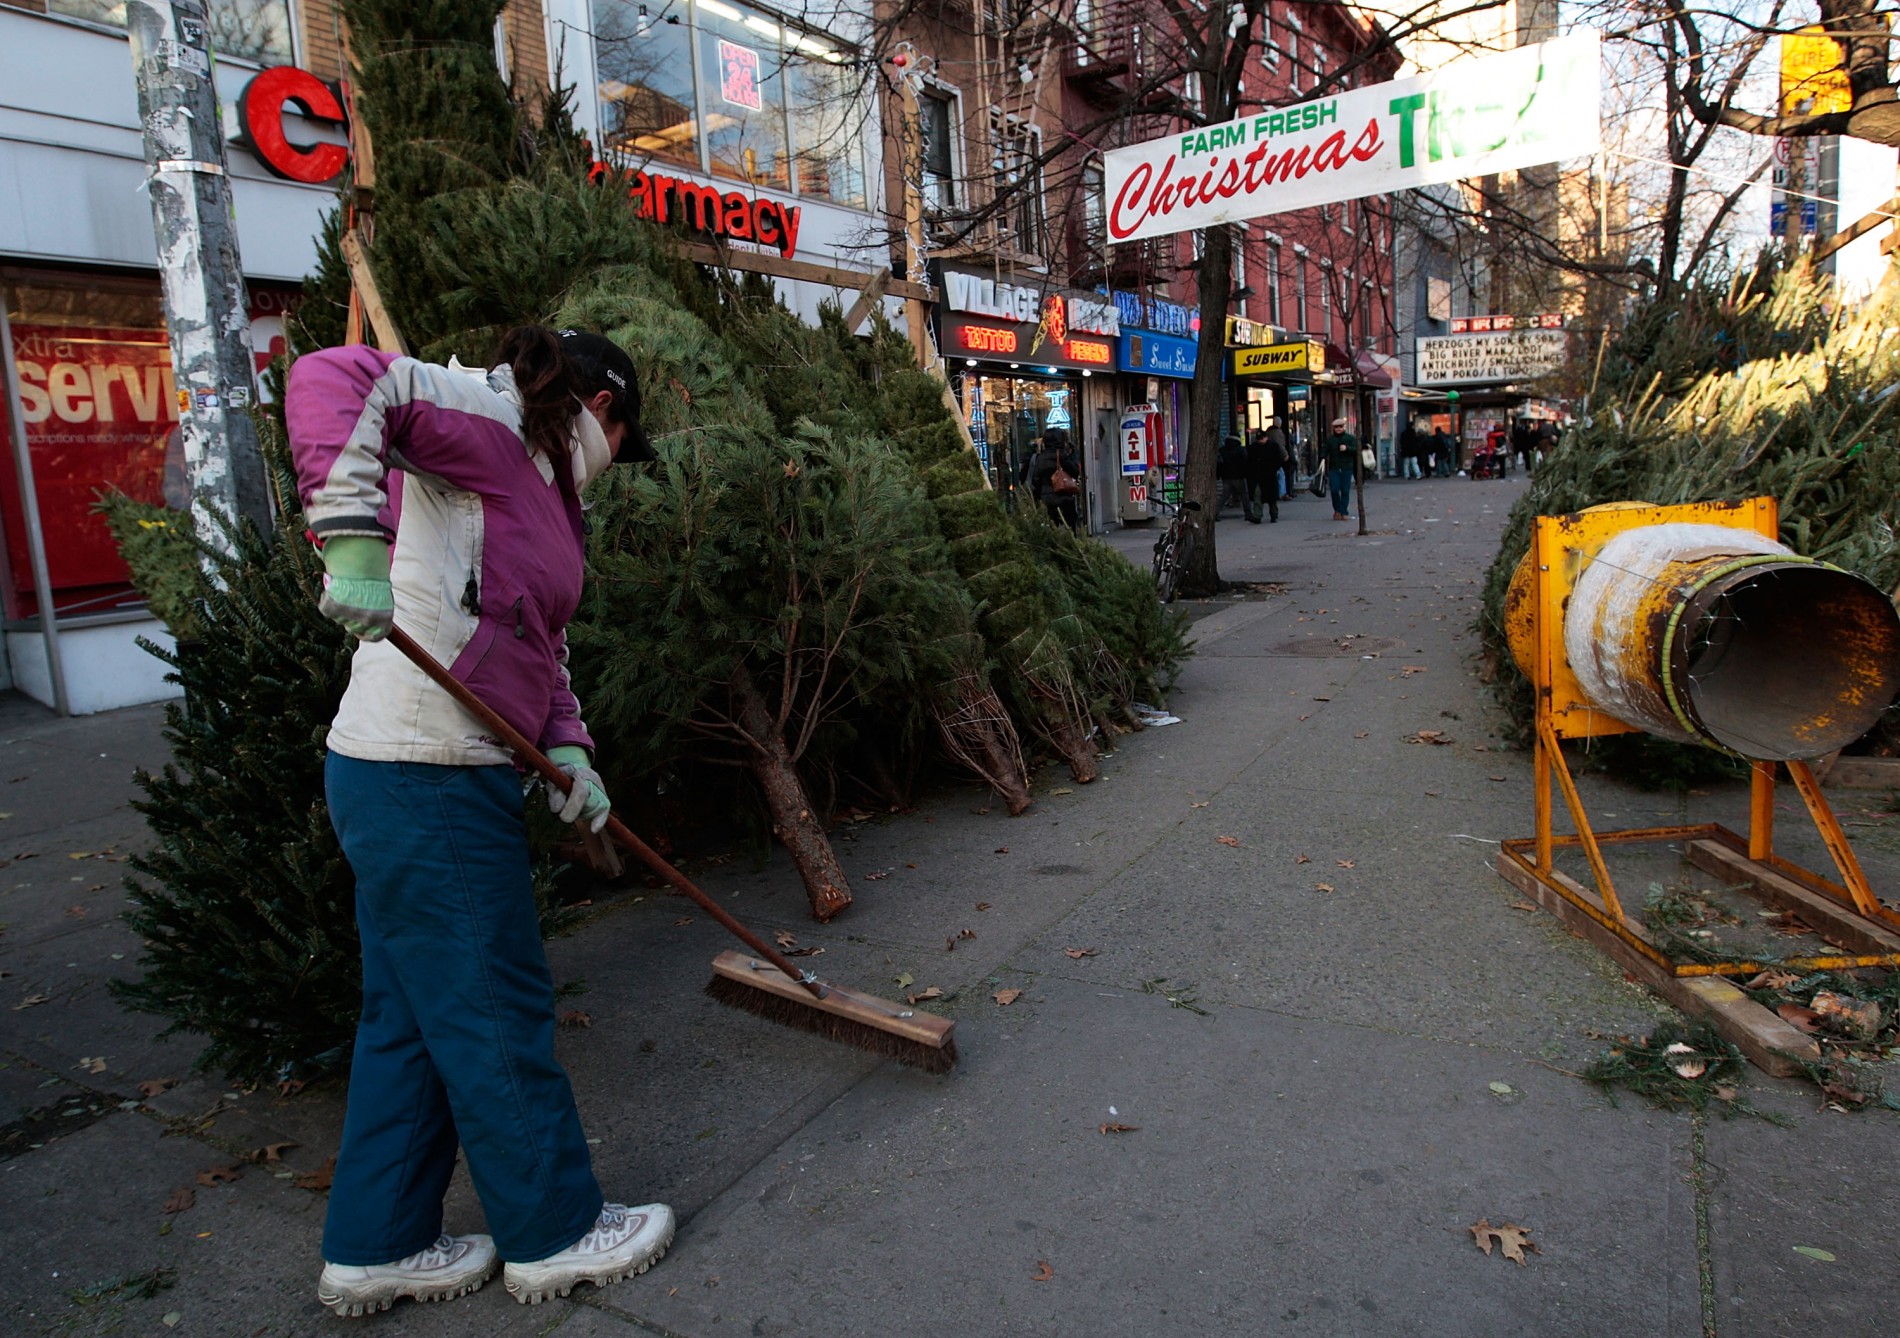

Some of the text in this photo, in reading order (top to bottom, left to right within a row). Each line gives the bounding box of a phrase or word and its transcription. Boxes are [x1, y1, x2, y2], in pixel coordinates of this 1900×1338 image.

[722, 43, 756, 68] OPEN
[727, 61, 753, 89] 24
[723, 83, 759, 108] HOURS
[1181, 99, 1337, 159] FARM FRESH
[1109, 118, 1384, 239] Christmas
[944, 271, 1040, 324] VILLAGE
[963, 325, 1017, 353] TATTOO
[1234, 319, 1274, 347] SUBWAY
[1476, 338, 1491, 347] MY
[1494, 337, 1513, 346] SON
[15, 334, 74, 358] xtra
[1242, 349, 1303, 367] SUBWAY
[1429, 351, 1447, 360] BIG
[1452, 350, 1481, 358] RIVER
[1421, 360, 1478, 370] ANTICHRIST
[1426, 370, 1447, 380] POM
[1488, 369, 1498, 377] EL
[15, 349, 180, 424] servi
[606, 369, 626, 389] GUIDE
[1127, 404, 1152, 413] ATM
[1128, 431, 1140, 460] ATM
